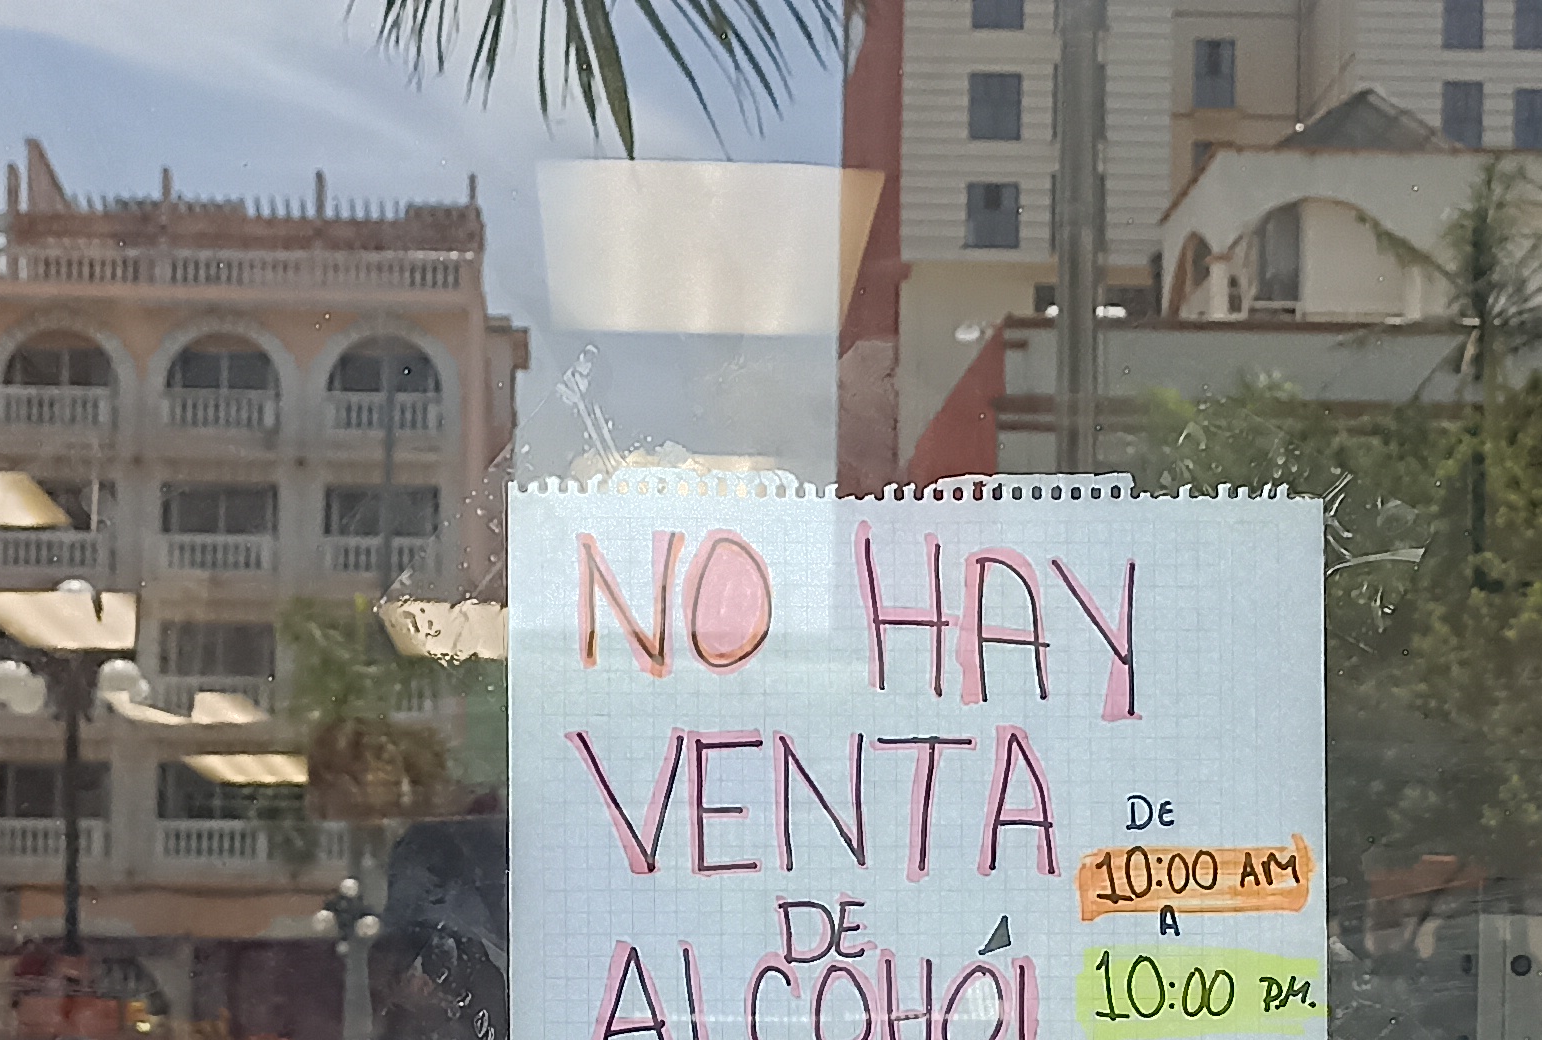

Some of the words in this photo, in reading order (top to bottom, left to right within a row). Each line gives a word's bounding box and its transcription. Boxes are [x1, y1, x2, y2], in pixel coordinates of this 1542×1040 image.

[577, 528, 774, 677] NO
[854, 521, 1141, 719] HAY
[566, 725, 1057, 880] VENTA
[1126, 795, 1175, 830] DE
[1096, 846, 1219, 904] 10:00
[1240, 852, 1301, 889] AM
[777, 893, 875, 967] DE
[1159, 905, 1180, 936] A
[1096, 951, 1235, 1021] 10:00
